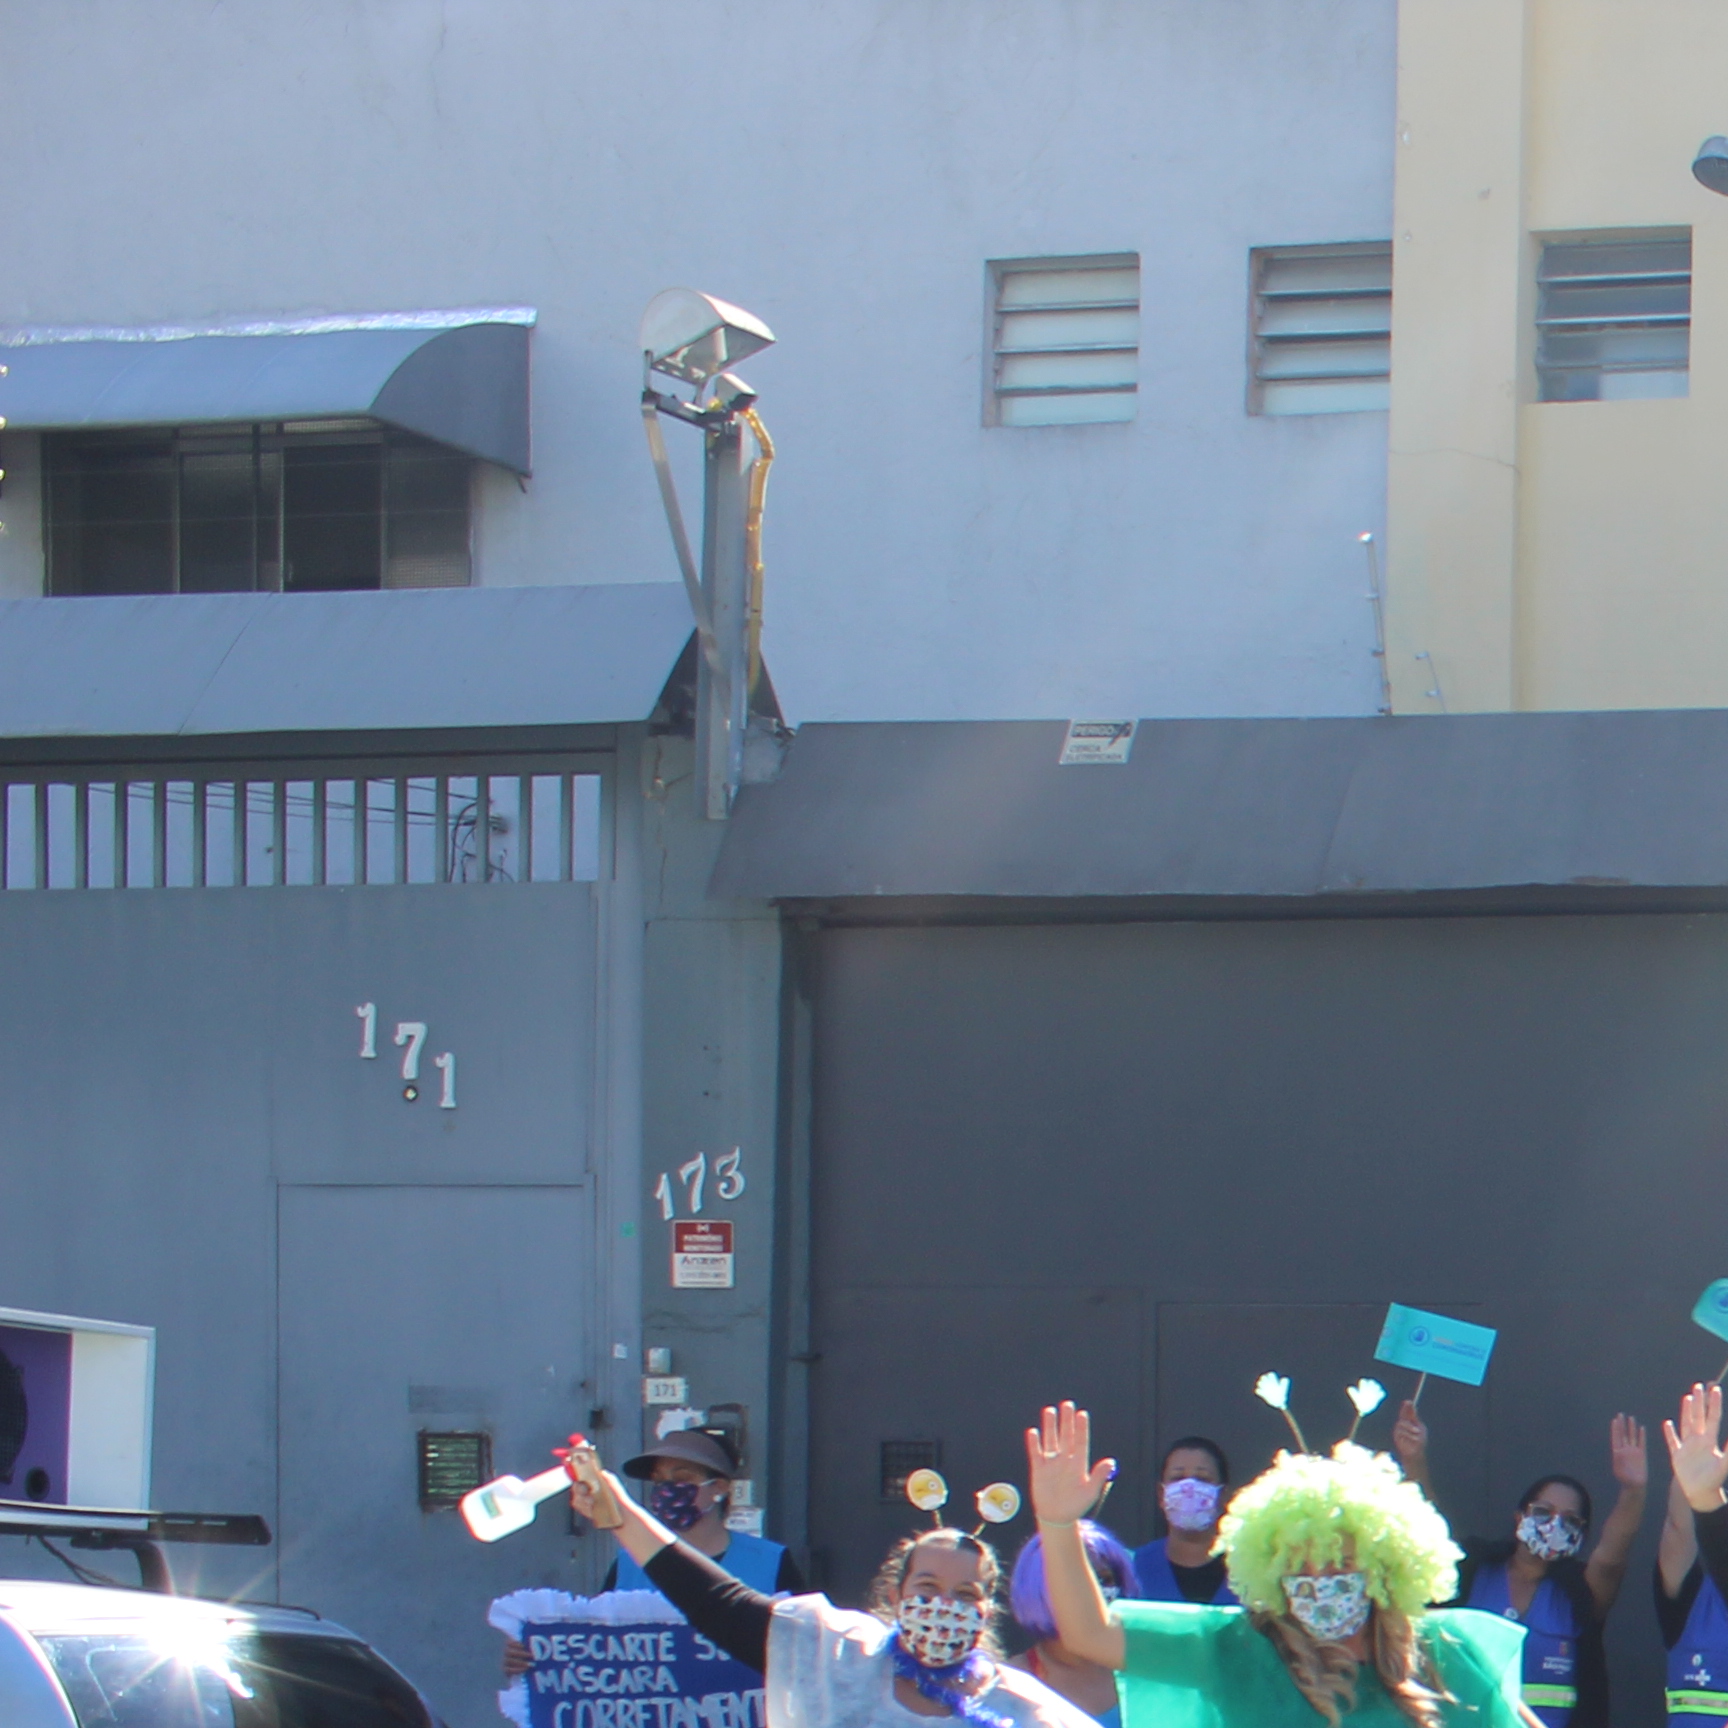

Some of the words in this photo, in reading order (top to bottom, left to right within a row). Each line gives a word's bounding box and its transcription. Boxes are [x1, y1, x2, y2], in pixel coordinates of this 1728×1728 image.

[654, 1146, 745, 1220] 173
[654, 1384, 677, 1397] 171
[530, 1632, 676, 1662] DESCARTE
[534, 1662, 679, 1694] MÁSCARA
